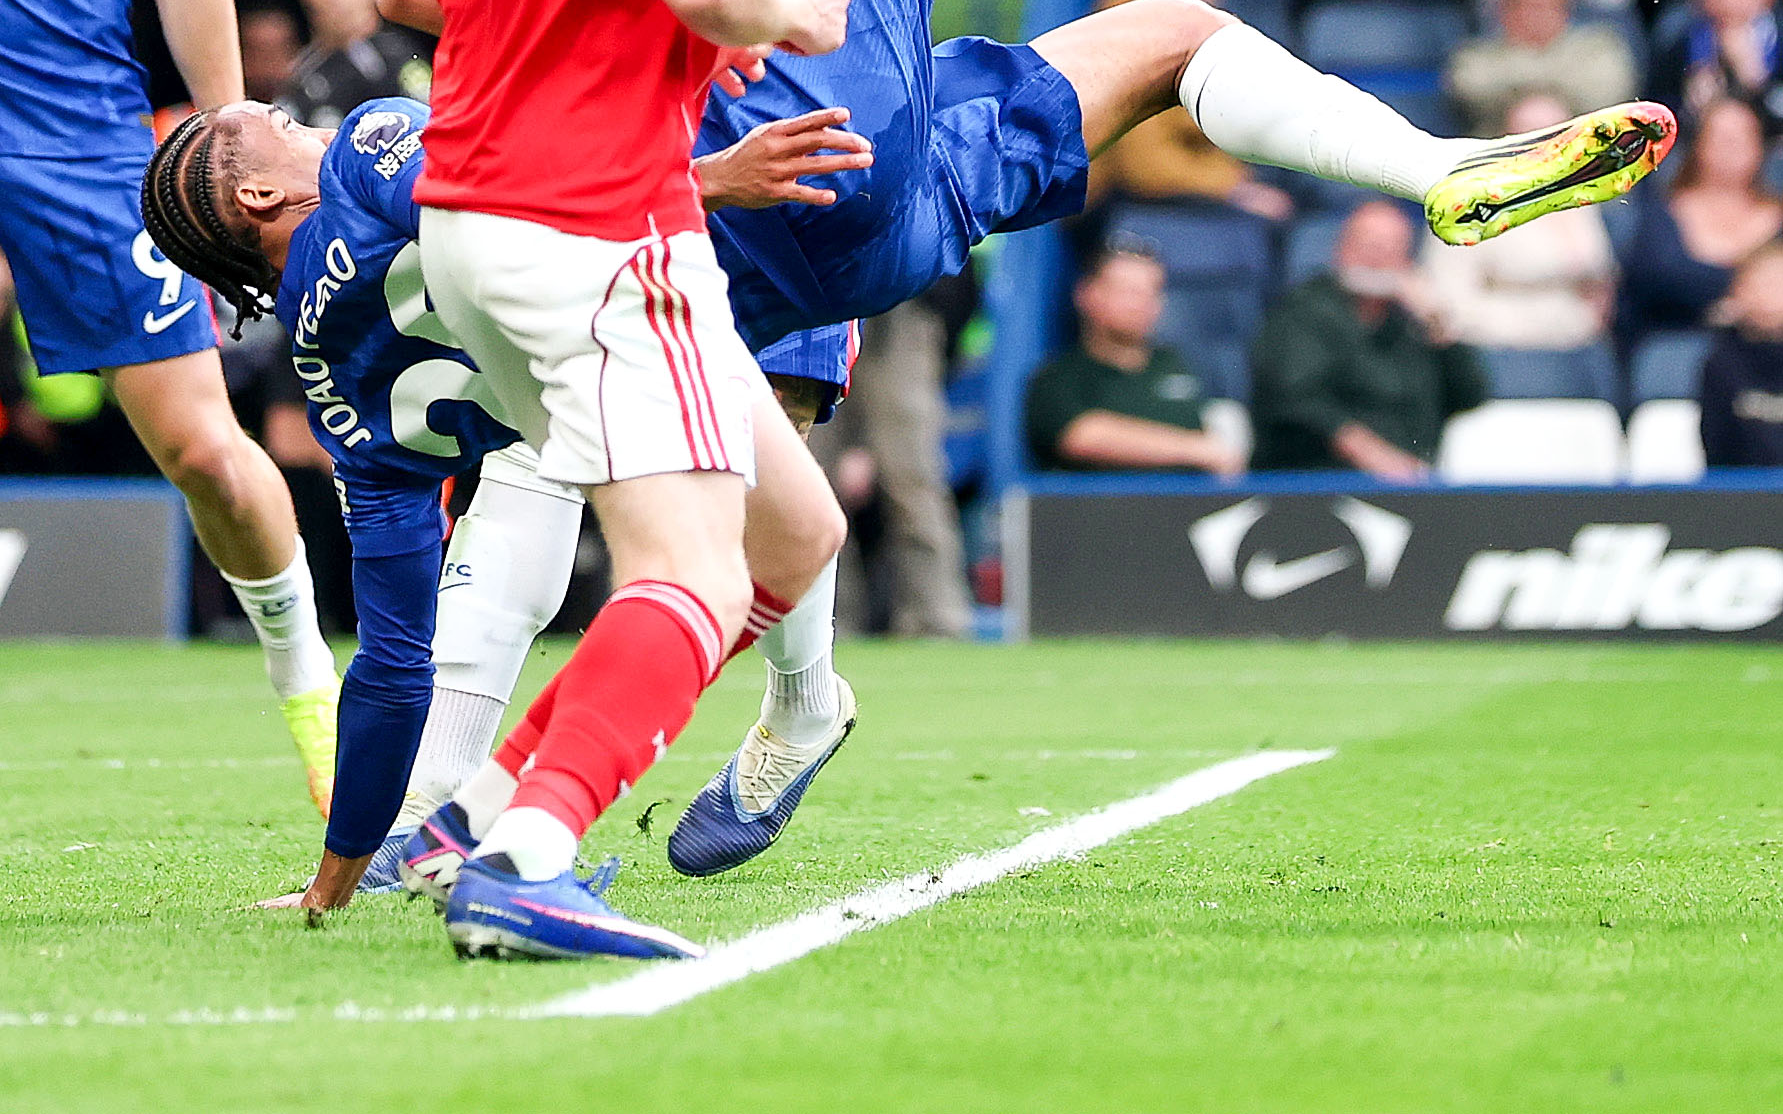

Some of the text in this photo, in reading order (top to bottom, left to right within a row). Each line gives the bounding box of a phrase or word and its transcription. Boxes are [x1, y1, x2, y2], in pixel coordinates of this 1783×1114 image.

[374, 152, 395, 174] No
[131, 228, 184, 306] 9
[1444, 522, 1783, 632] nike
